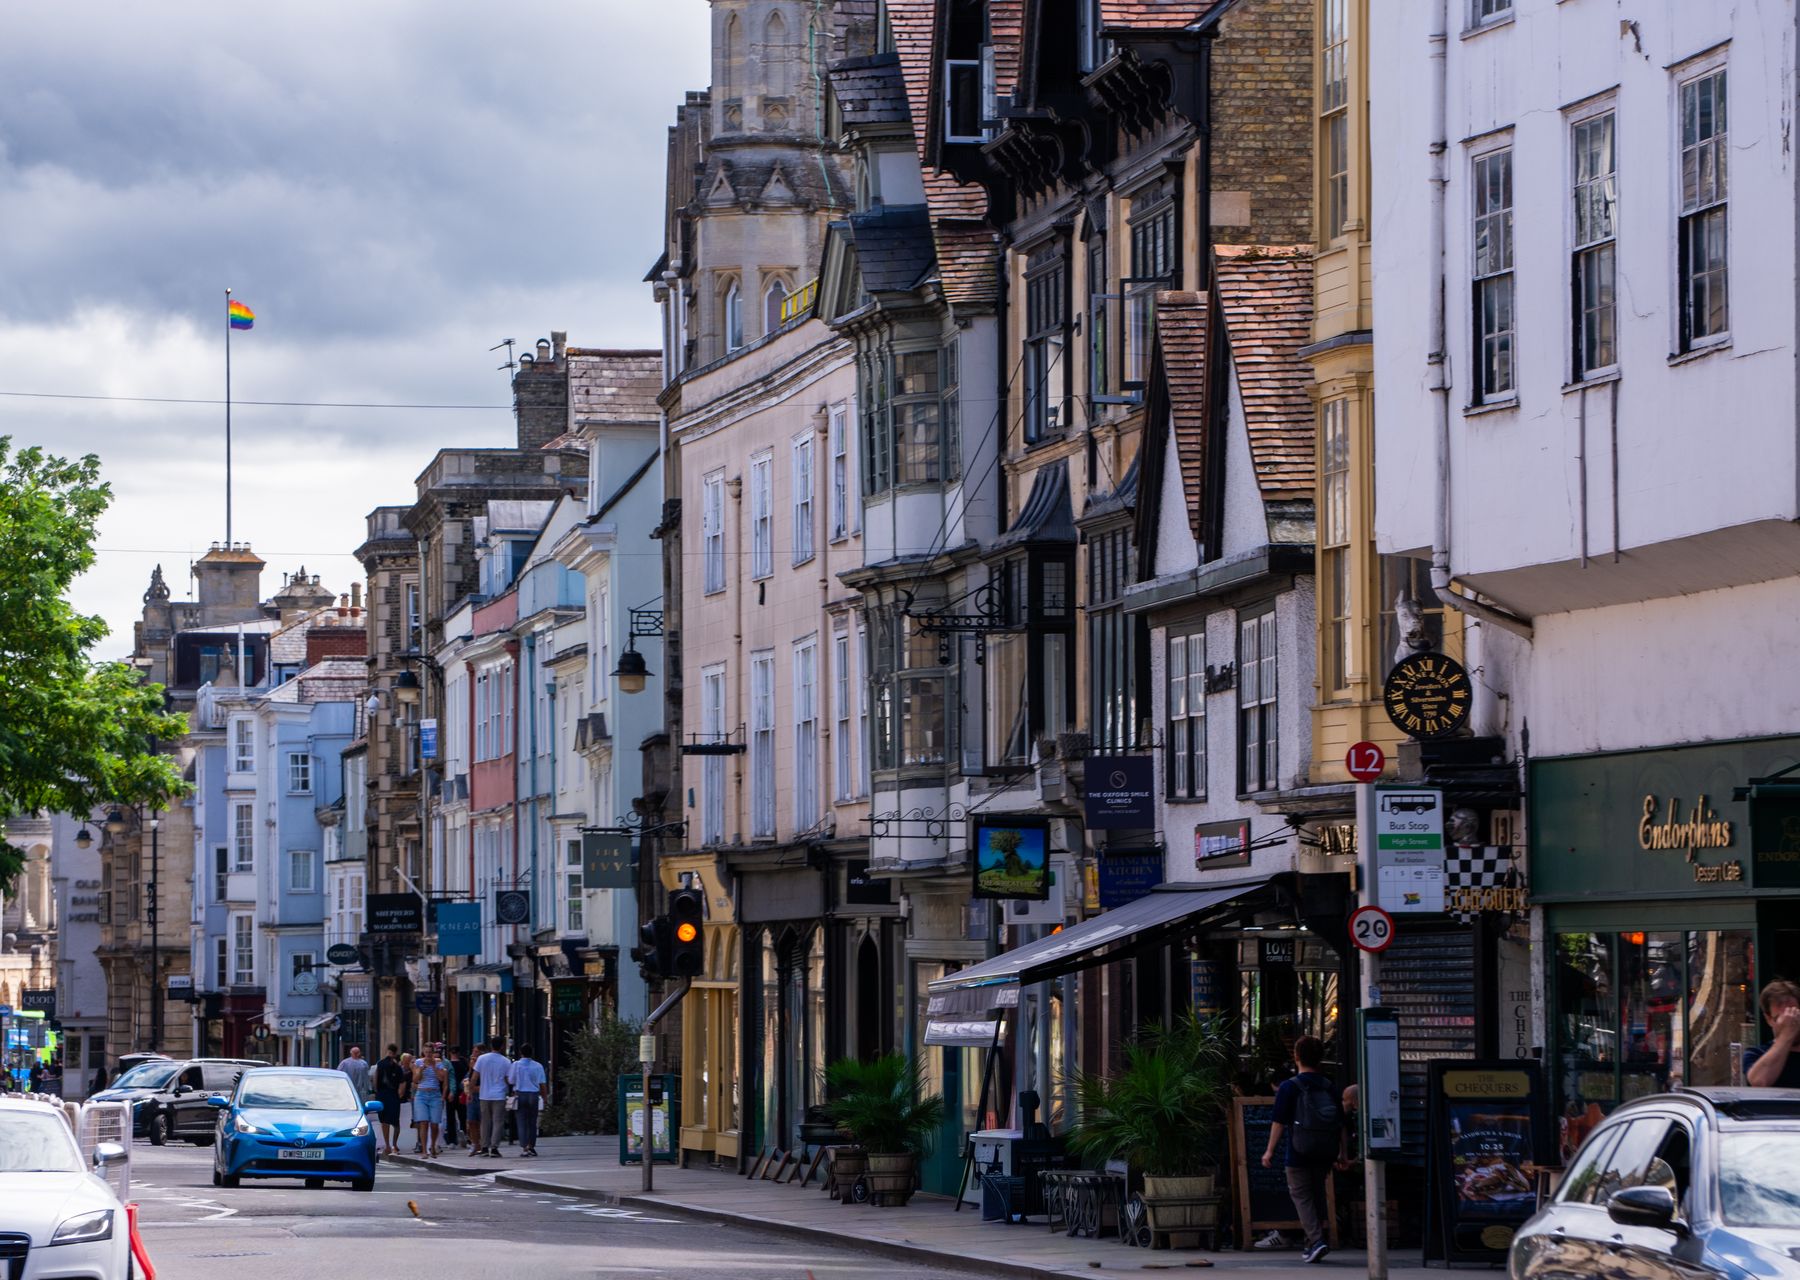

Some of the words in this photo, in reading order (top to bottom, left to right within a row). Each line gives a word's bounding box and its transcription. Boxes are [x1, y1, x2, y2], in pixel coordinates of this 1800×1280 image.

[1418, 659, 1433, 671] XII
[1448, 674, 1460, 684] II
[1452, 690, 1465, 698] III
[1426, 719, 1439, 731] VI
[1350, 749, 1381, 772] L2
[1389, 821, 1406, 831] Bus
[1408, 821, 1429, 832] Stop
[1639, 794, 1731, 863] Endorphins
[1392, 838, 1407, 847] High
[591, 862, 623, 871] IVY
[1108, 866, 1153, 875] KITCHEN
[1693, 863, 1721, 882] Dessert
[75, 879, 101, 889] OLD
[72, 895, 98, 905] BAN
[1455, 888, 1531, 912] CHEQUERS
[68, 912, 99, 922] HOTE
[440, 922, 479, 931] KNEAD
[1357, 920, 1388, 939] 20
[1266, 942, 1293, 955] LOVE
[347, 987, 369, 997] WINE
[1509, 991, 1531, 1002] THE
[23, 995, 55, 1005] QUOD
[1476, 1074, 1494, 1082] THE
[1455, 1083, 1520, 1095] CHEQUERS
[1480, 1143, 1504, 1151] 10.25
